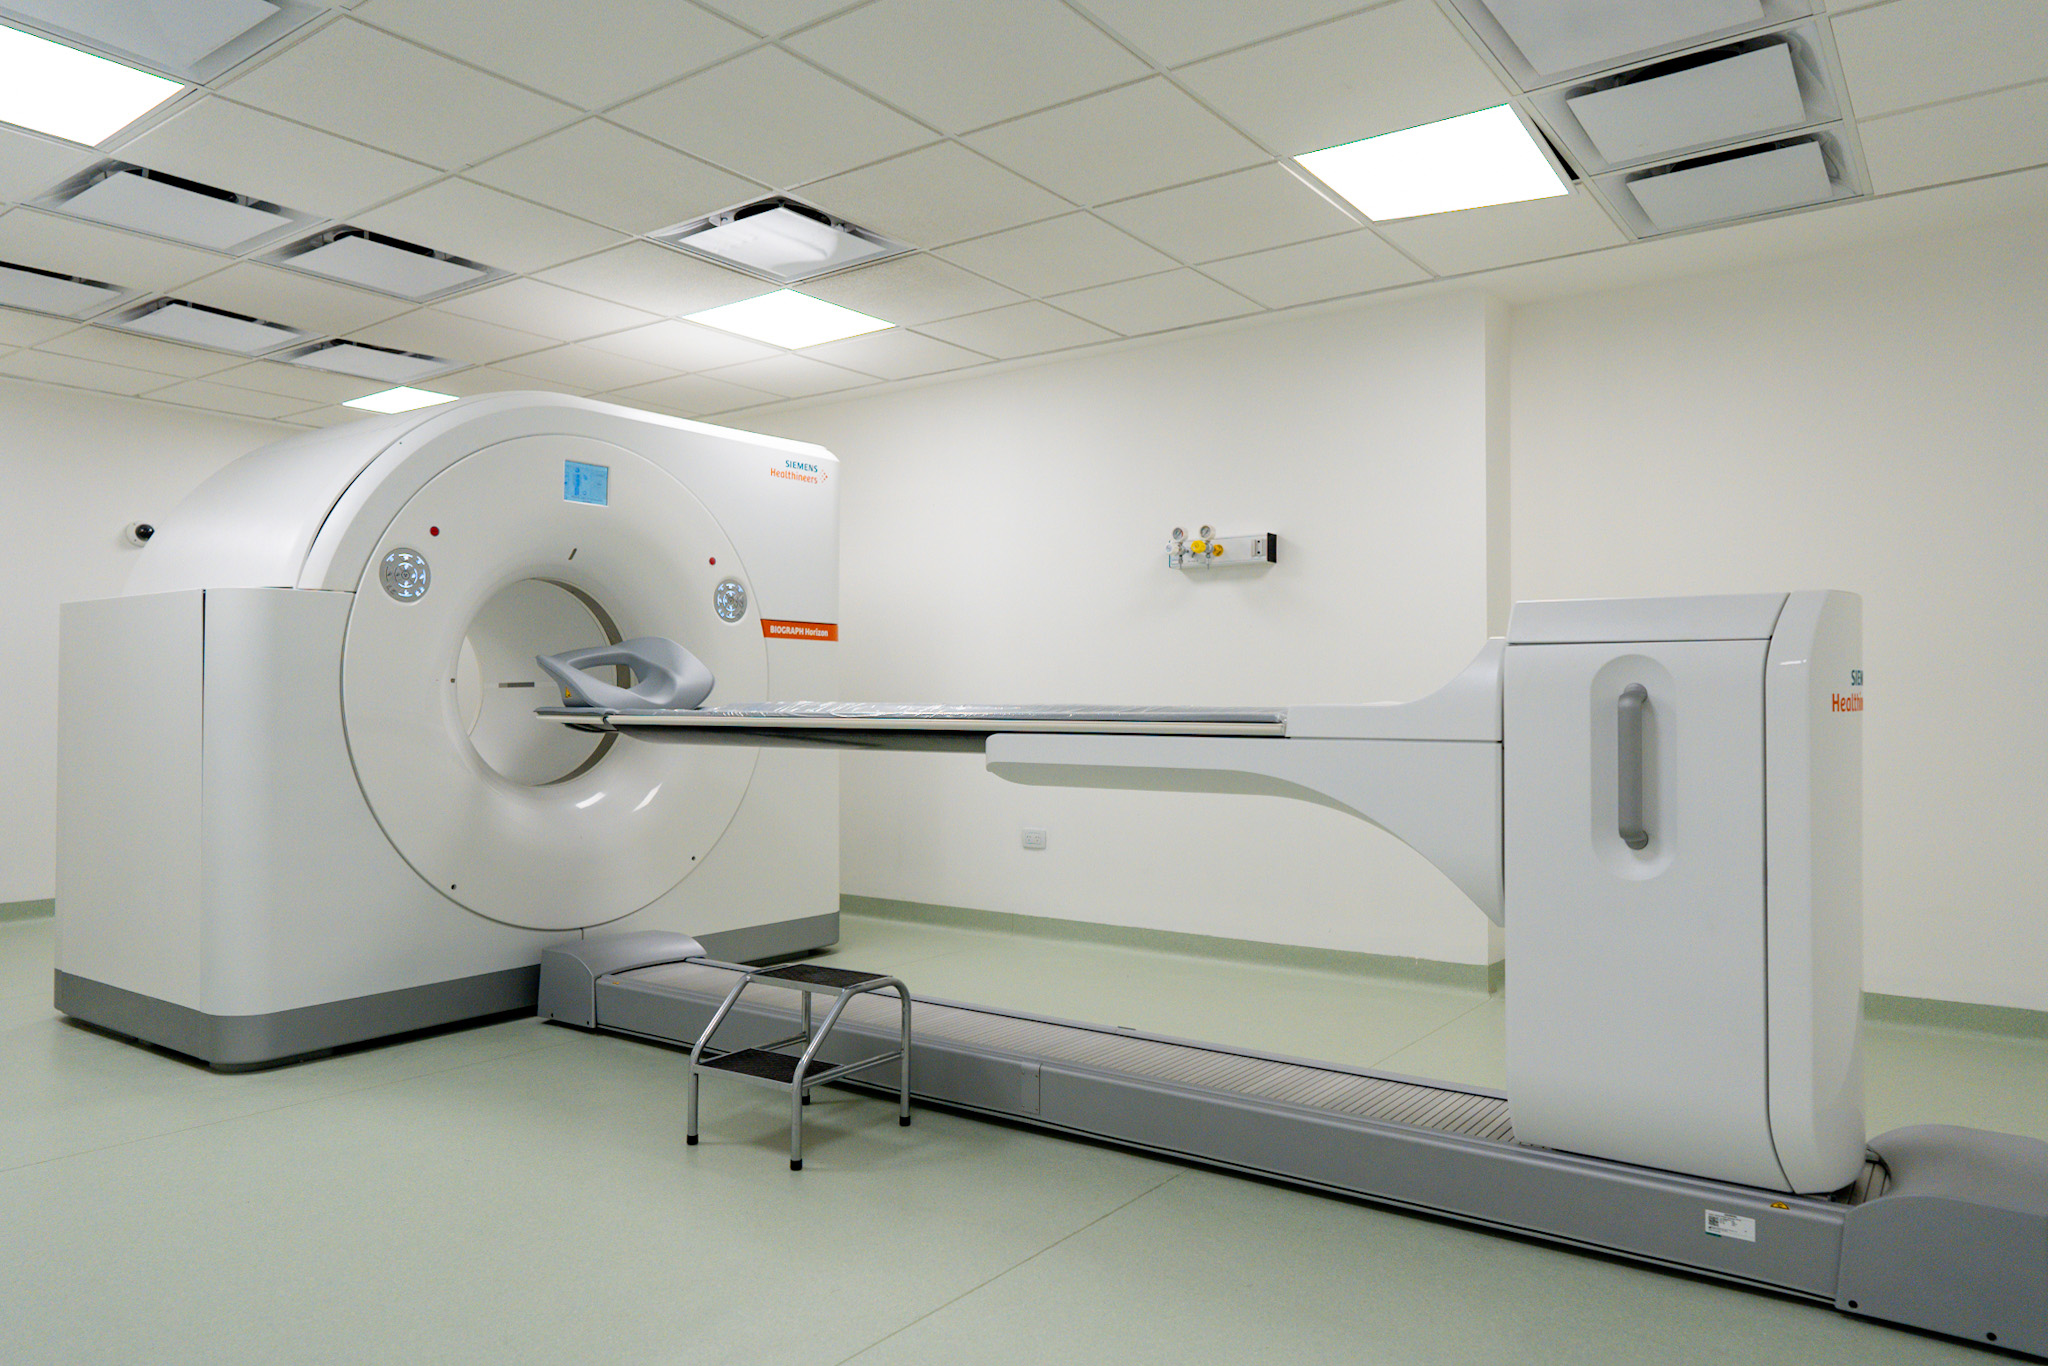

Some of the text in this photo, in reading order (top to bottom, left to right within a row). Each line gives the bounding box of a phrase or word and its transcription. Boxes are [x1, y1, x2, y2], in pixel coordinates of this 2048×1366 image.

[785, 460, 818, 473] SIEMENS
[770, 467, 818, 484] Healthineers
[770, 625, 829, 637] BIOGRAPH Horizon
